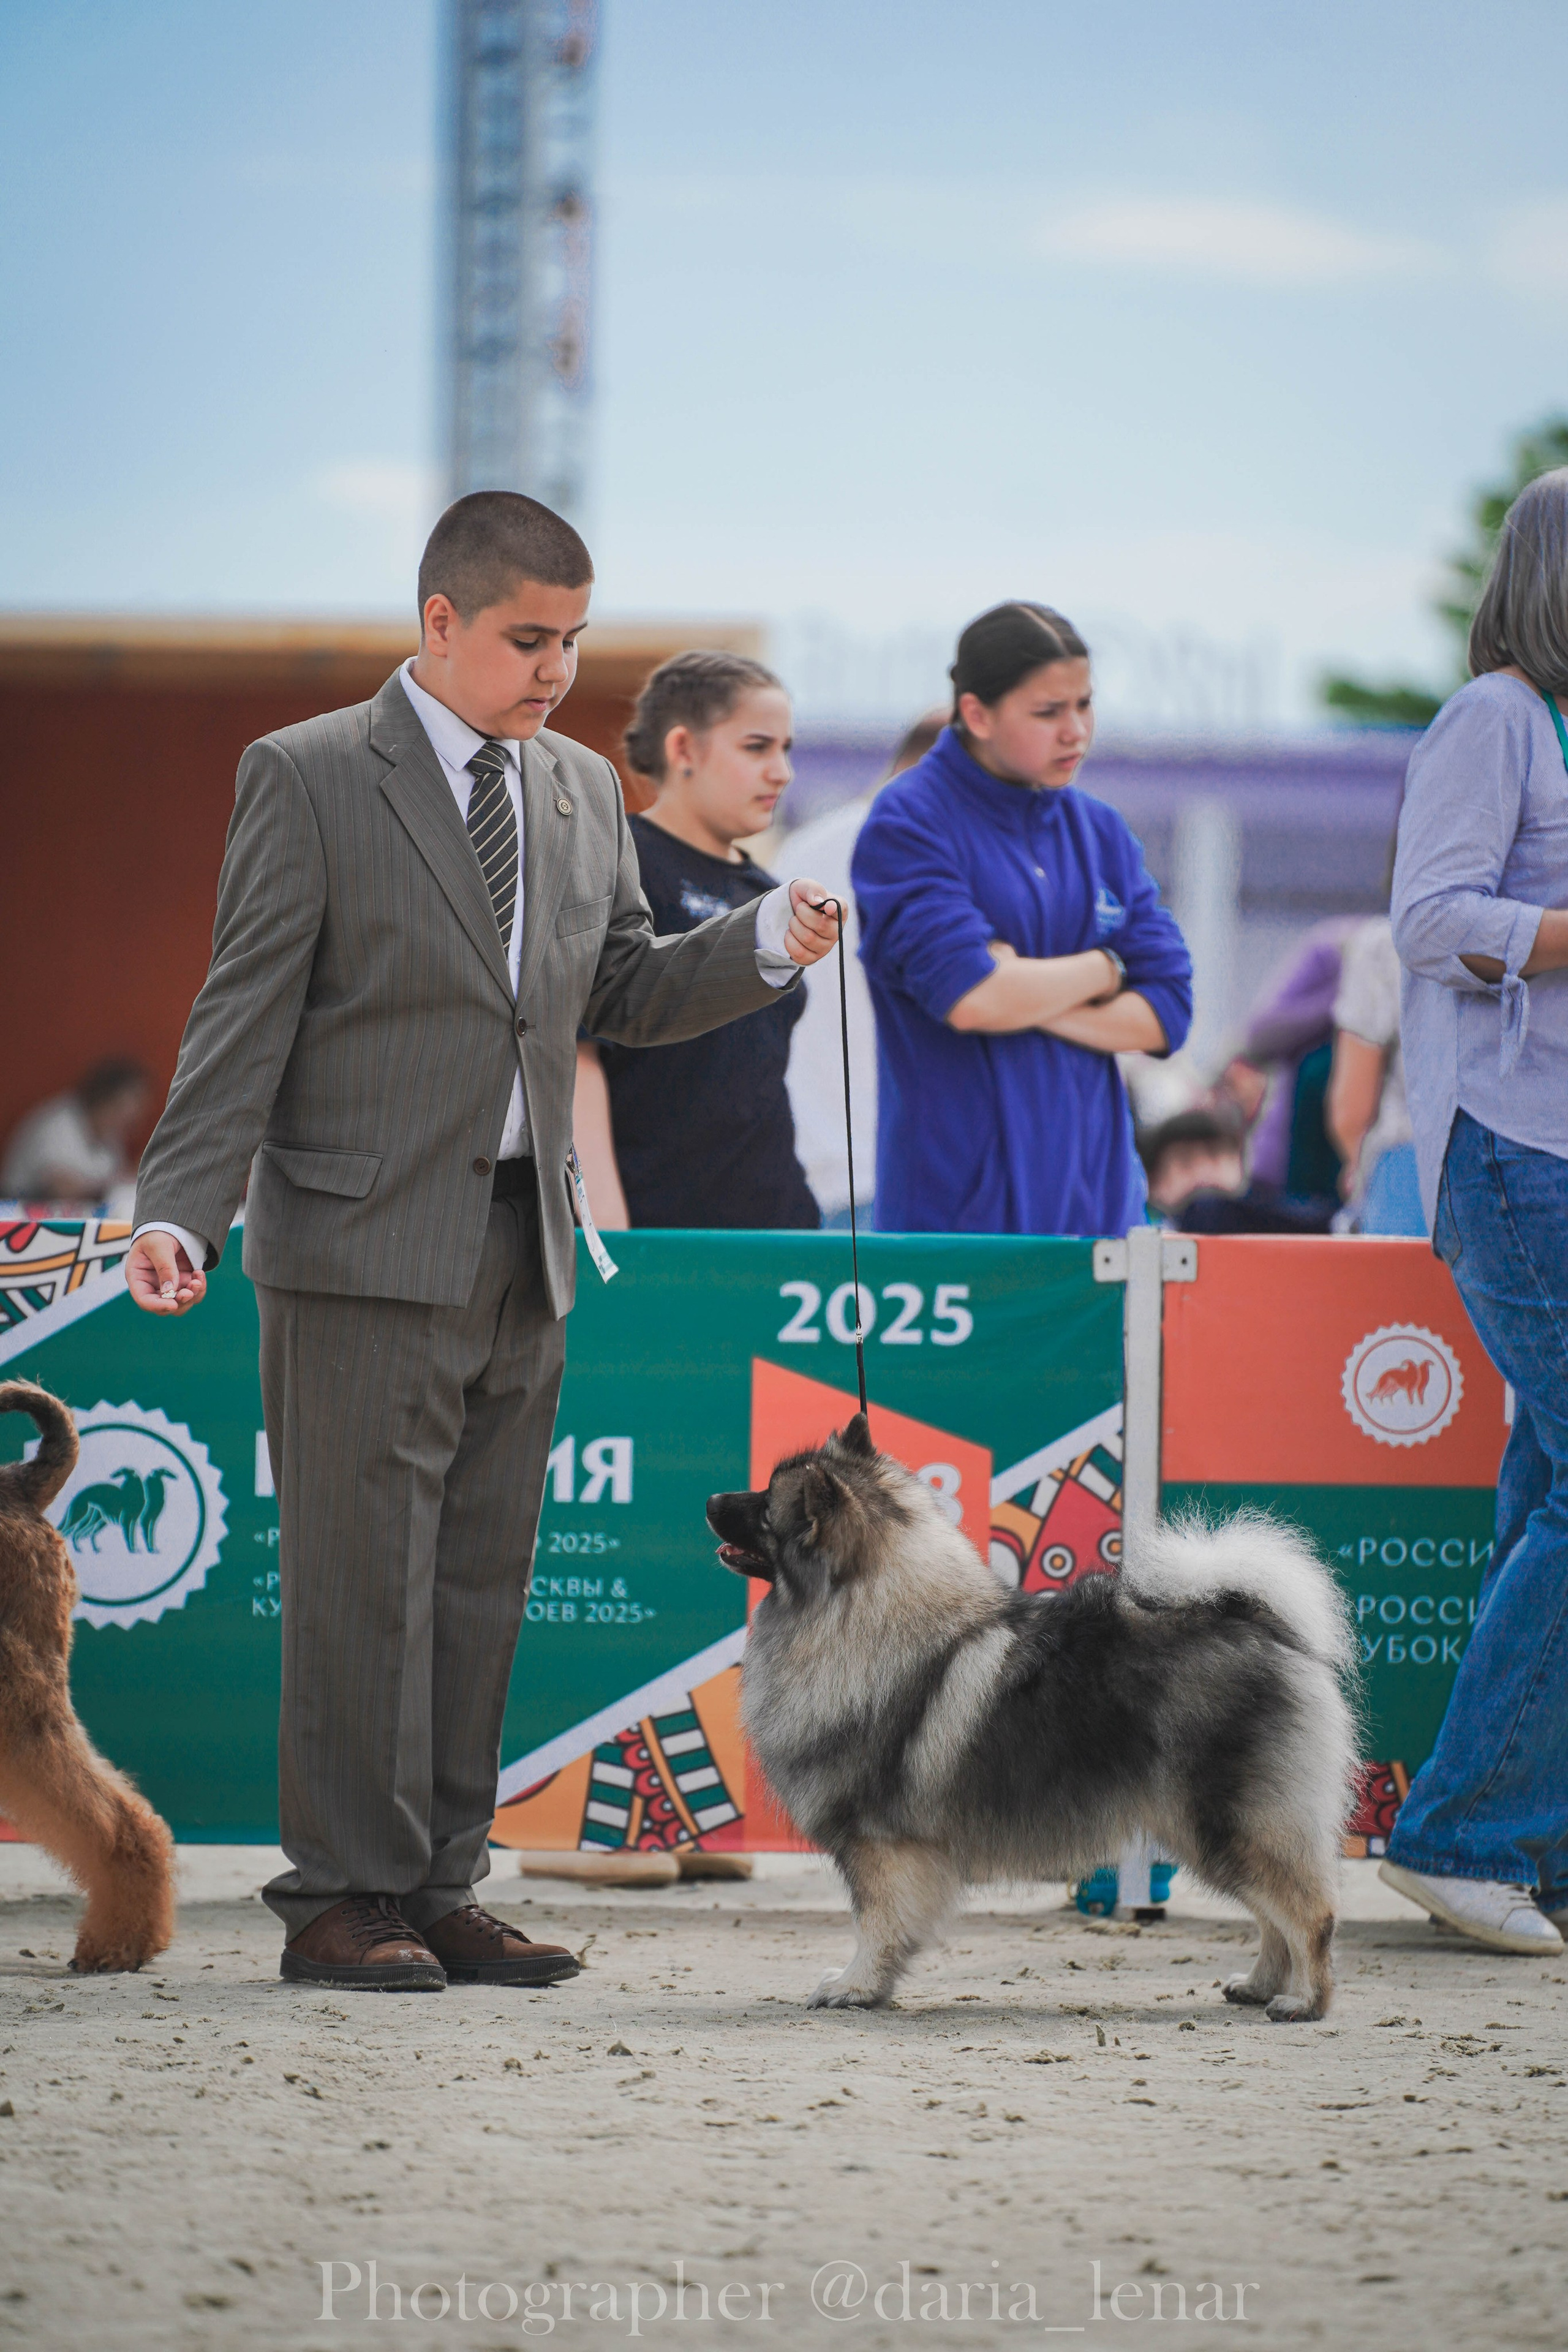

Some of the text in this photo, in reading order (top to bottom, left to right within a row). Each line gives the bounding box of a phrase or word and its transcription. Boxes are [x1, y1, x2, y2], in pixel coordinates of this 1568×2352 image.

[777, 1281, 973, 1346] 2025
[549, 1531, 620, 1553] 2025»
[1338, 1536, 1493, 1567] «РОССИ
[530, 1575, 628, 1598] СКВЫ &
[526, 1600, 657, 1623] ОЕВ 2025»
[1360, 1634, 1461, 1664] УБОК
